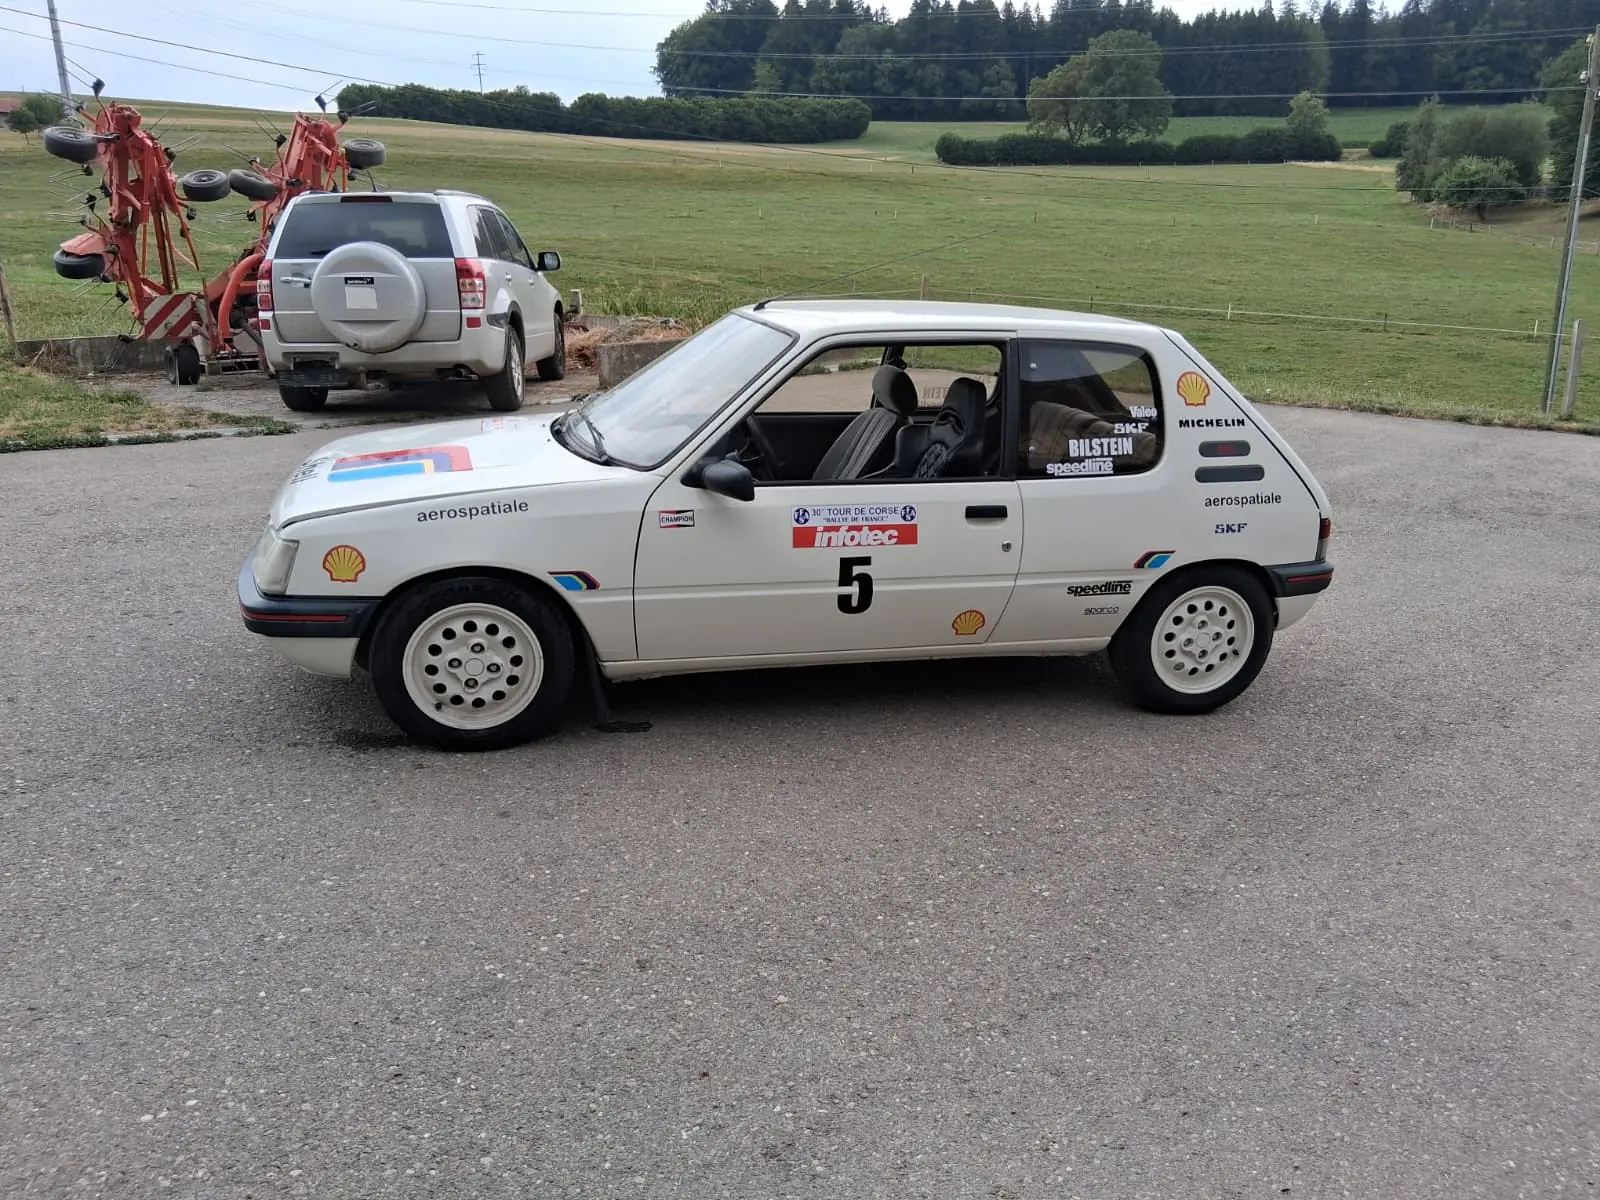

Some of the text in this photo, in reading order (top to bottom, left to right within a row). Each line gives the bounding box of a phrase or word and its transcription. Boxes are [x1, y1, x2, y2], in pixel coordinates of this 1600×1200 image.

[1129, 405, 1158, 418] Valeo
[1114, 422, 1149, 434] SKF
[1178, 418, 1246, 428] MICHELIN
[1068, 437, 1133, 457] BILSTEIN
[1046, 457, 1114, 476] speedline
[1204, 491, 1282, 508] aerospatiale
[417, 499, 530, 523] aerospatiale
[661, 513, 693, 524] CHAMPION
[827, 507, 852, 516] TOUR
[854, 507, 866, 516] DE
[868, 506, 899, 515] CORSE
[1214, 523, 1248, 534] SKF
[814, 525, 899, 548] infotec
[837, 556, 874, 614] 5
[1066, 580, 1133, 597] speedline
[1083, 606, 1120, 616] sparco
